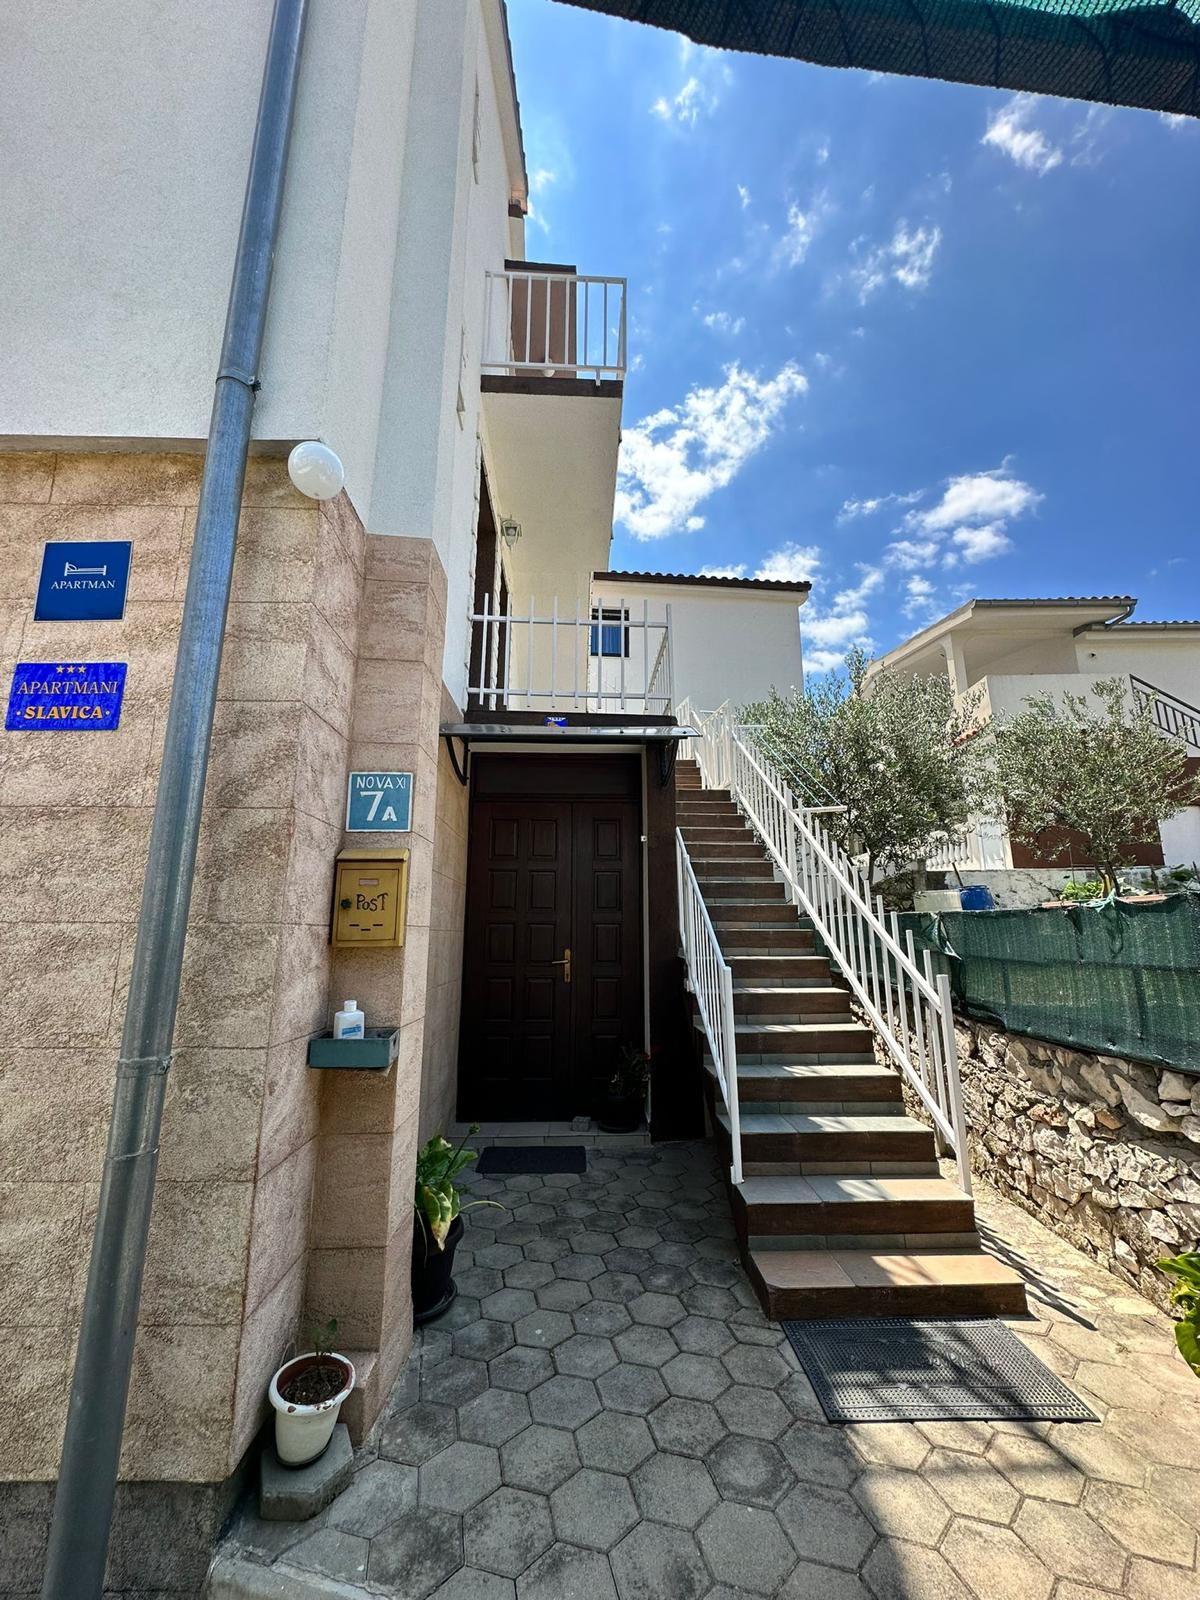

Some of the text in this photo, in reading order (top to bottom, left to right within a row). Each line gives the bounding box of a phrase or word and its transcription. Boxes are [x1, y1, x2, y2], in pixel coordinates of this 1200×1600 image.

[51, 580, 116, 590] APARTMAN
[17, 681, 119, 695] APARTMANI
[23, 705, 104, 720] SLAVICA
[356, 776, 394, 789] NOVA
